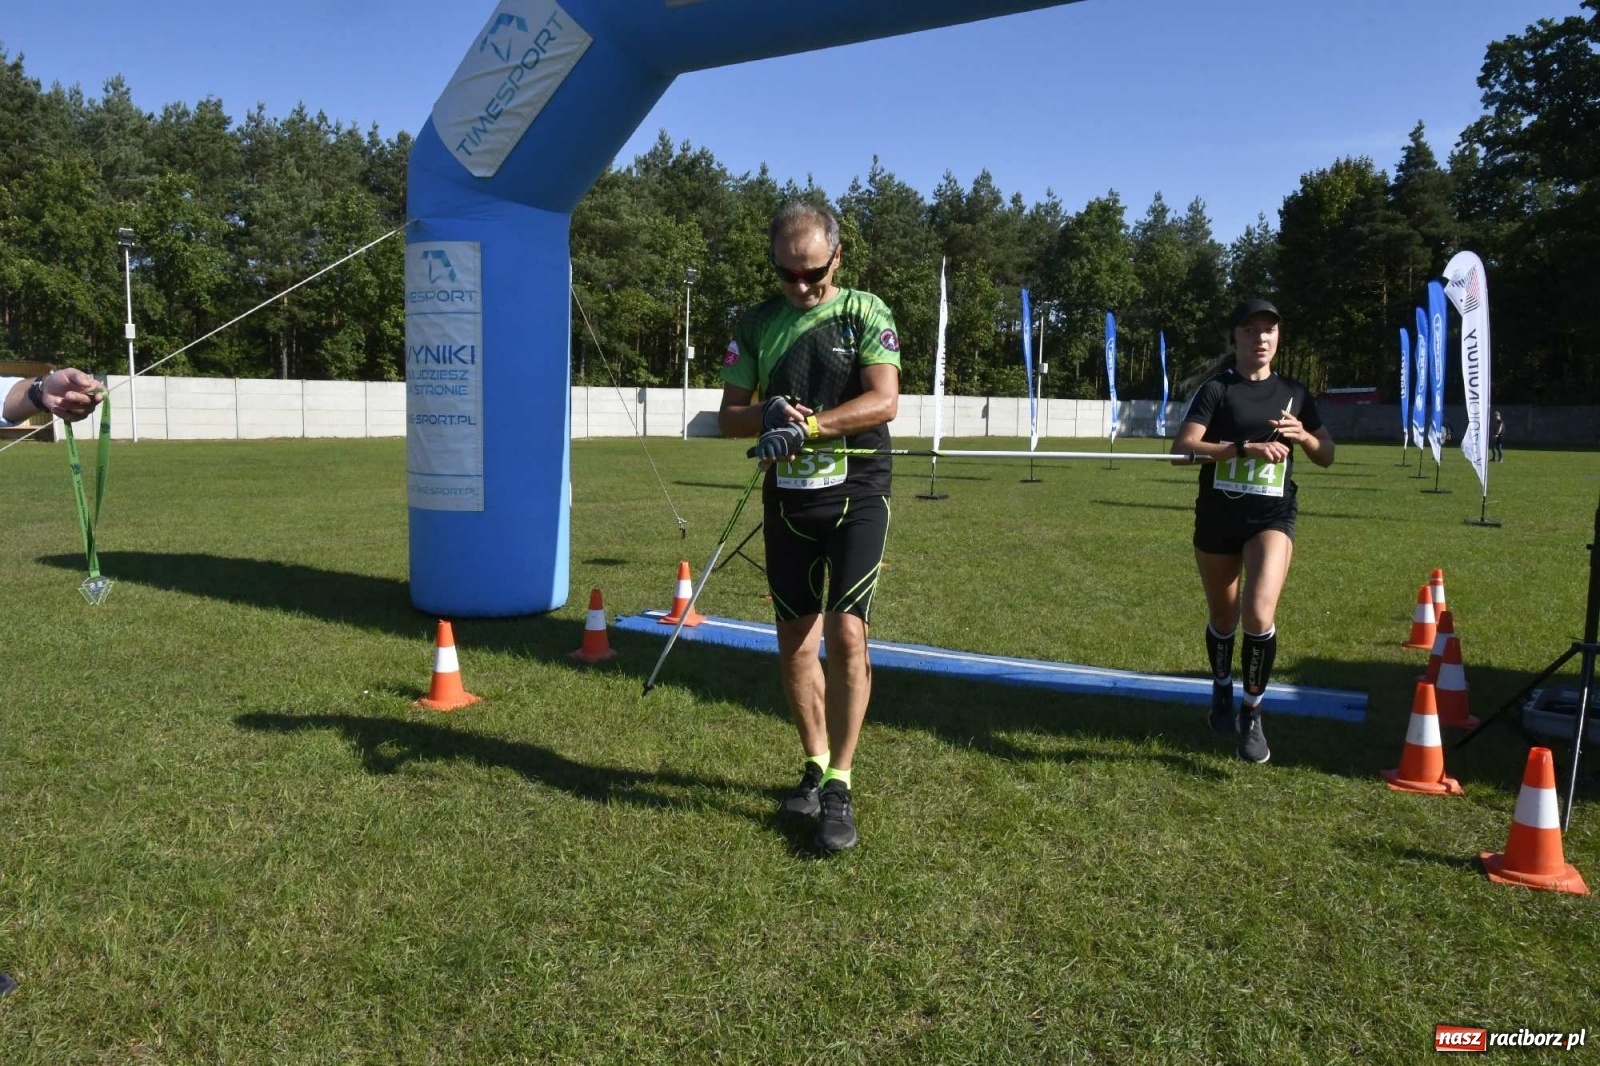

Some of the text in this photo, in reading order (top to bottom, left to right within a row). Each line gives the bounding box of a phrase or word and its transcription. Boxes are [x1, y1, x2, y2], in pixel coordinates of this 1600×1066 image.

[456, 10, 564, 156] TIMESPORT
[408, 290, 477, 303] ESPORT
[787, 454, 836, 475] 135
[1225, 458, 1277, 484] 114
